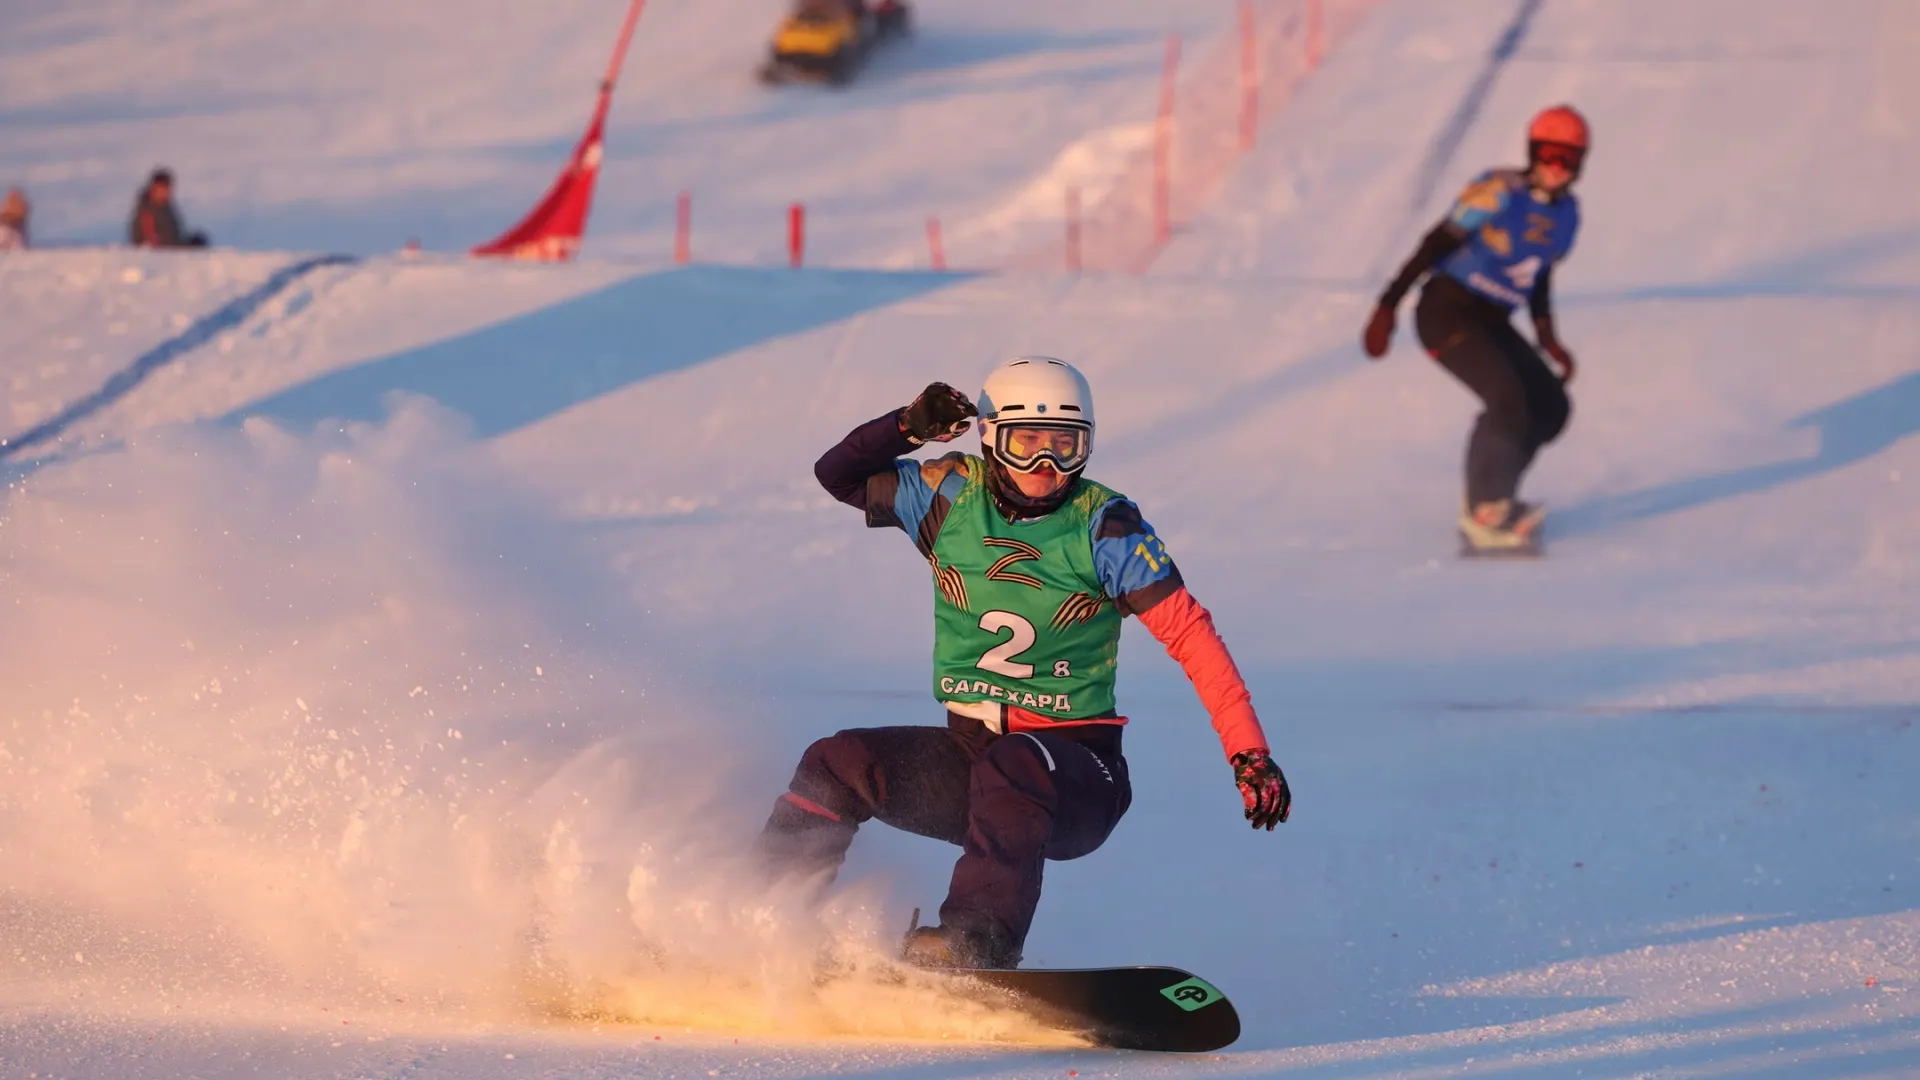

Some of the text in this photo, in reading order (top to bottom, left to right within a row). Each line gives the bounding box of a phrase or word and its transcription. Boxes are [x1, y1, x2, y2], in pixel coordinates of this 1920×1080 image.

[983, 536, 1045, 590] Z
[975, 609, 1037, 680] 2
[1052, 659, 1071, 678] 8
[940, 676, 1072, 713] САЛЕХАРД
